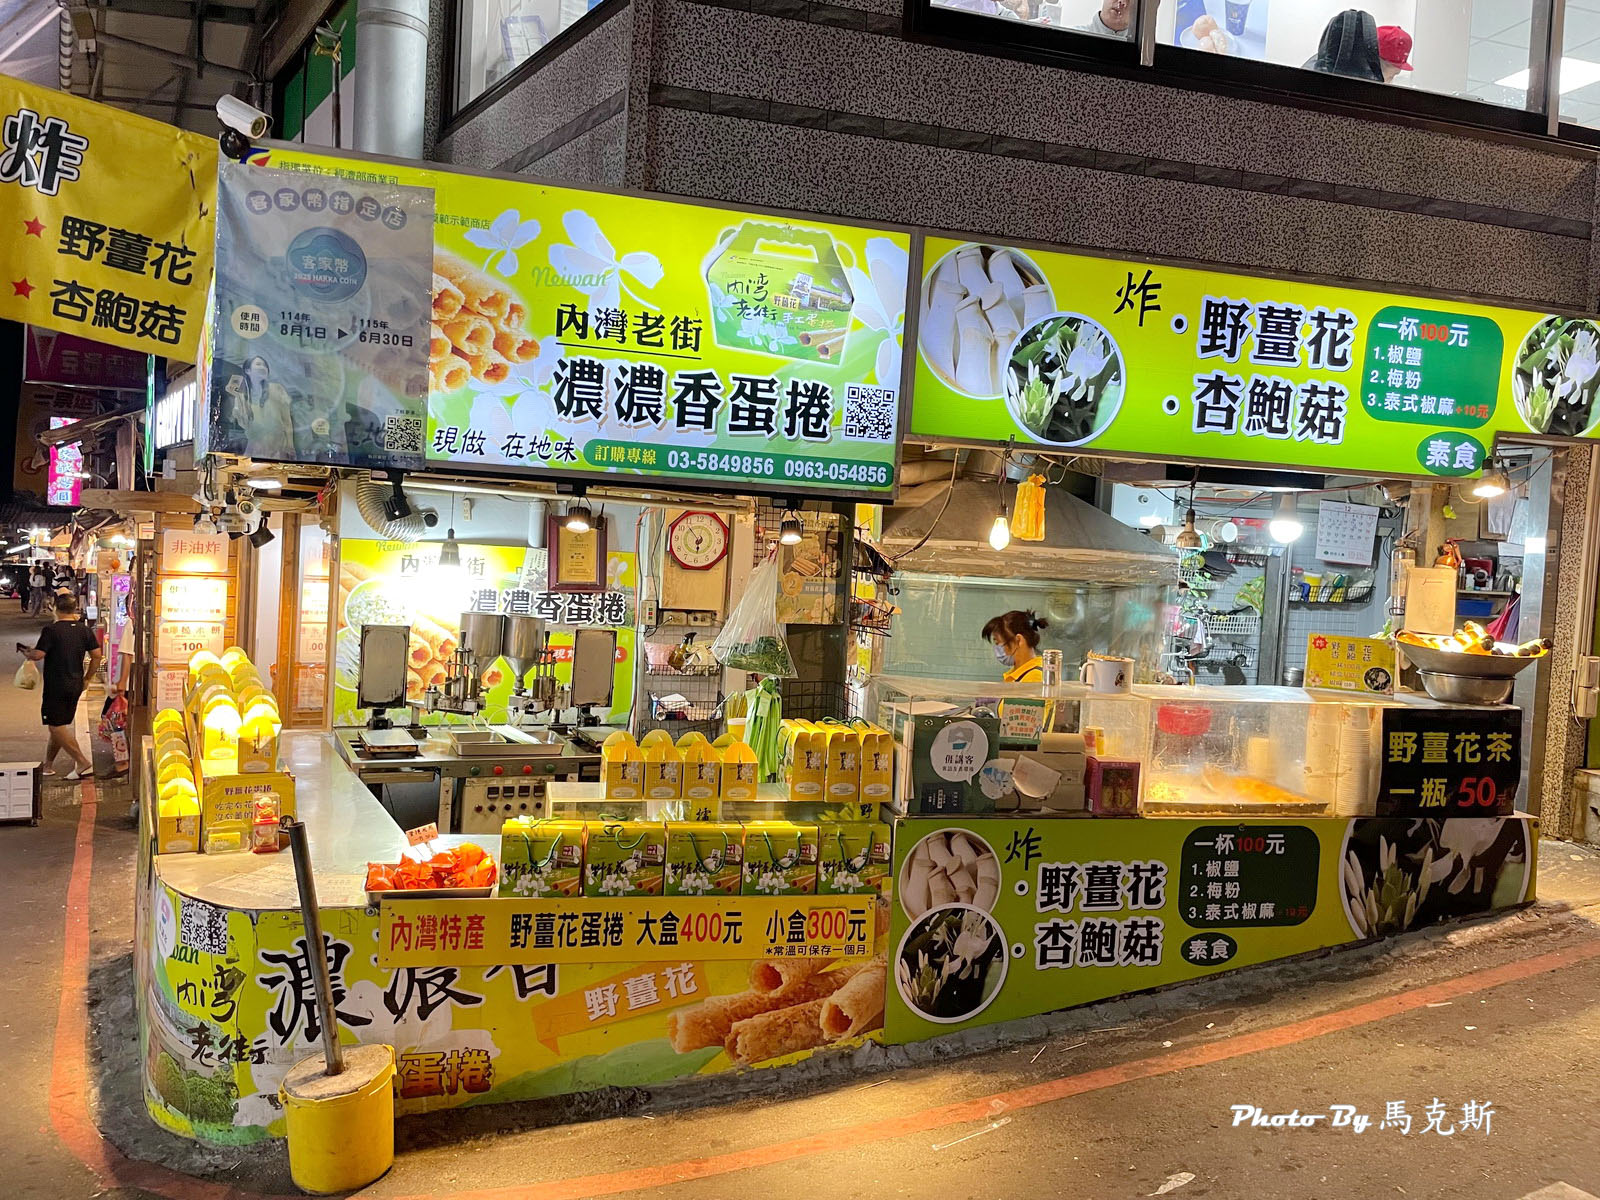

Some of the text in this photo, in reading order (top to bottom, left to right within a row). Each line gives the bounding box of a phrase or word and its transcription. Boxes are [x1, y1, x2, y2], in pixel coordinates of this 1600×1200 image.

[0, 108, 89, 196] 炸
[247, 189, 407, 232] 客家幣指定店
[57, 216, 197, 286] 野薑花
[302, 255, 350, 273] 客家幣
[531, 265, 609, 289] Neiwan
[49, 279, 187, 345] 杏鮑菇
[1114, 270, 1162, 327] 炸
[239, 322, 260, 332] 時間
[240, 312, 260, 321] 使用
[280, 311, 310, 321] 114年
[280, 324, 327, 339] 8月1日
[359, 319, 389, 329] 115年
[555, 303, 703, 352] 內灣老街
[1377, 316, 1469, 347] 一杯100元
[359, 332, 413, 347] 6月30日
[1199, 297, 1356, 368] 野薑花
[1373, 345, 1422, 366] 1.椒鹽
[1369, 369, 1421, 389] 2.梅粉
[552, 358, 834, 440] 濃濃香蛋捲
[1193, 373, 1346, 443] 杏鮑菇
[433, 429, 578, 462] 現做 在地味
[1426, 440, 1477, 470] 素食
[594, 445, 887, 484] 訂購專線 03-5849856 0963-054856
[171, 540, 221, 554] 非油炸
[401, 554, 486, 576] 內街
[470, 588, 626, 624] 濃濃香蛋捲
[1388, 732, 1513, 763] 野薑花茶
[1006, 827, 1042, 870] 炸
[1194, 833, 1286, 855] 一杯100元
[1192, 860, 1240, 878] 1.椒鹽
[1040, 863, 1166, 910] 野薑花
[1190, 882, 1241, 899] 2.梅粉
[391, 908, 868, 952] 內灣特產 野薑花蛋捲 大盒400元 小盒300元
[1035, 922, 1161, 968] 杏鮑菇
[1189, 939, 1230, 960] 素食
[584, 967, 698, 1021] 野薑花
[399, 1049, 493, 1099] 蛋捲
